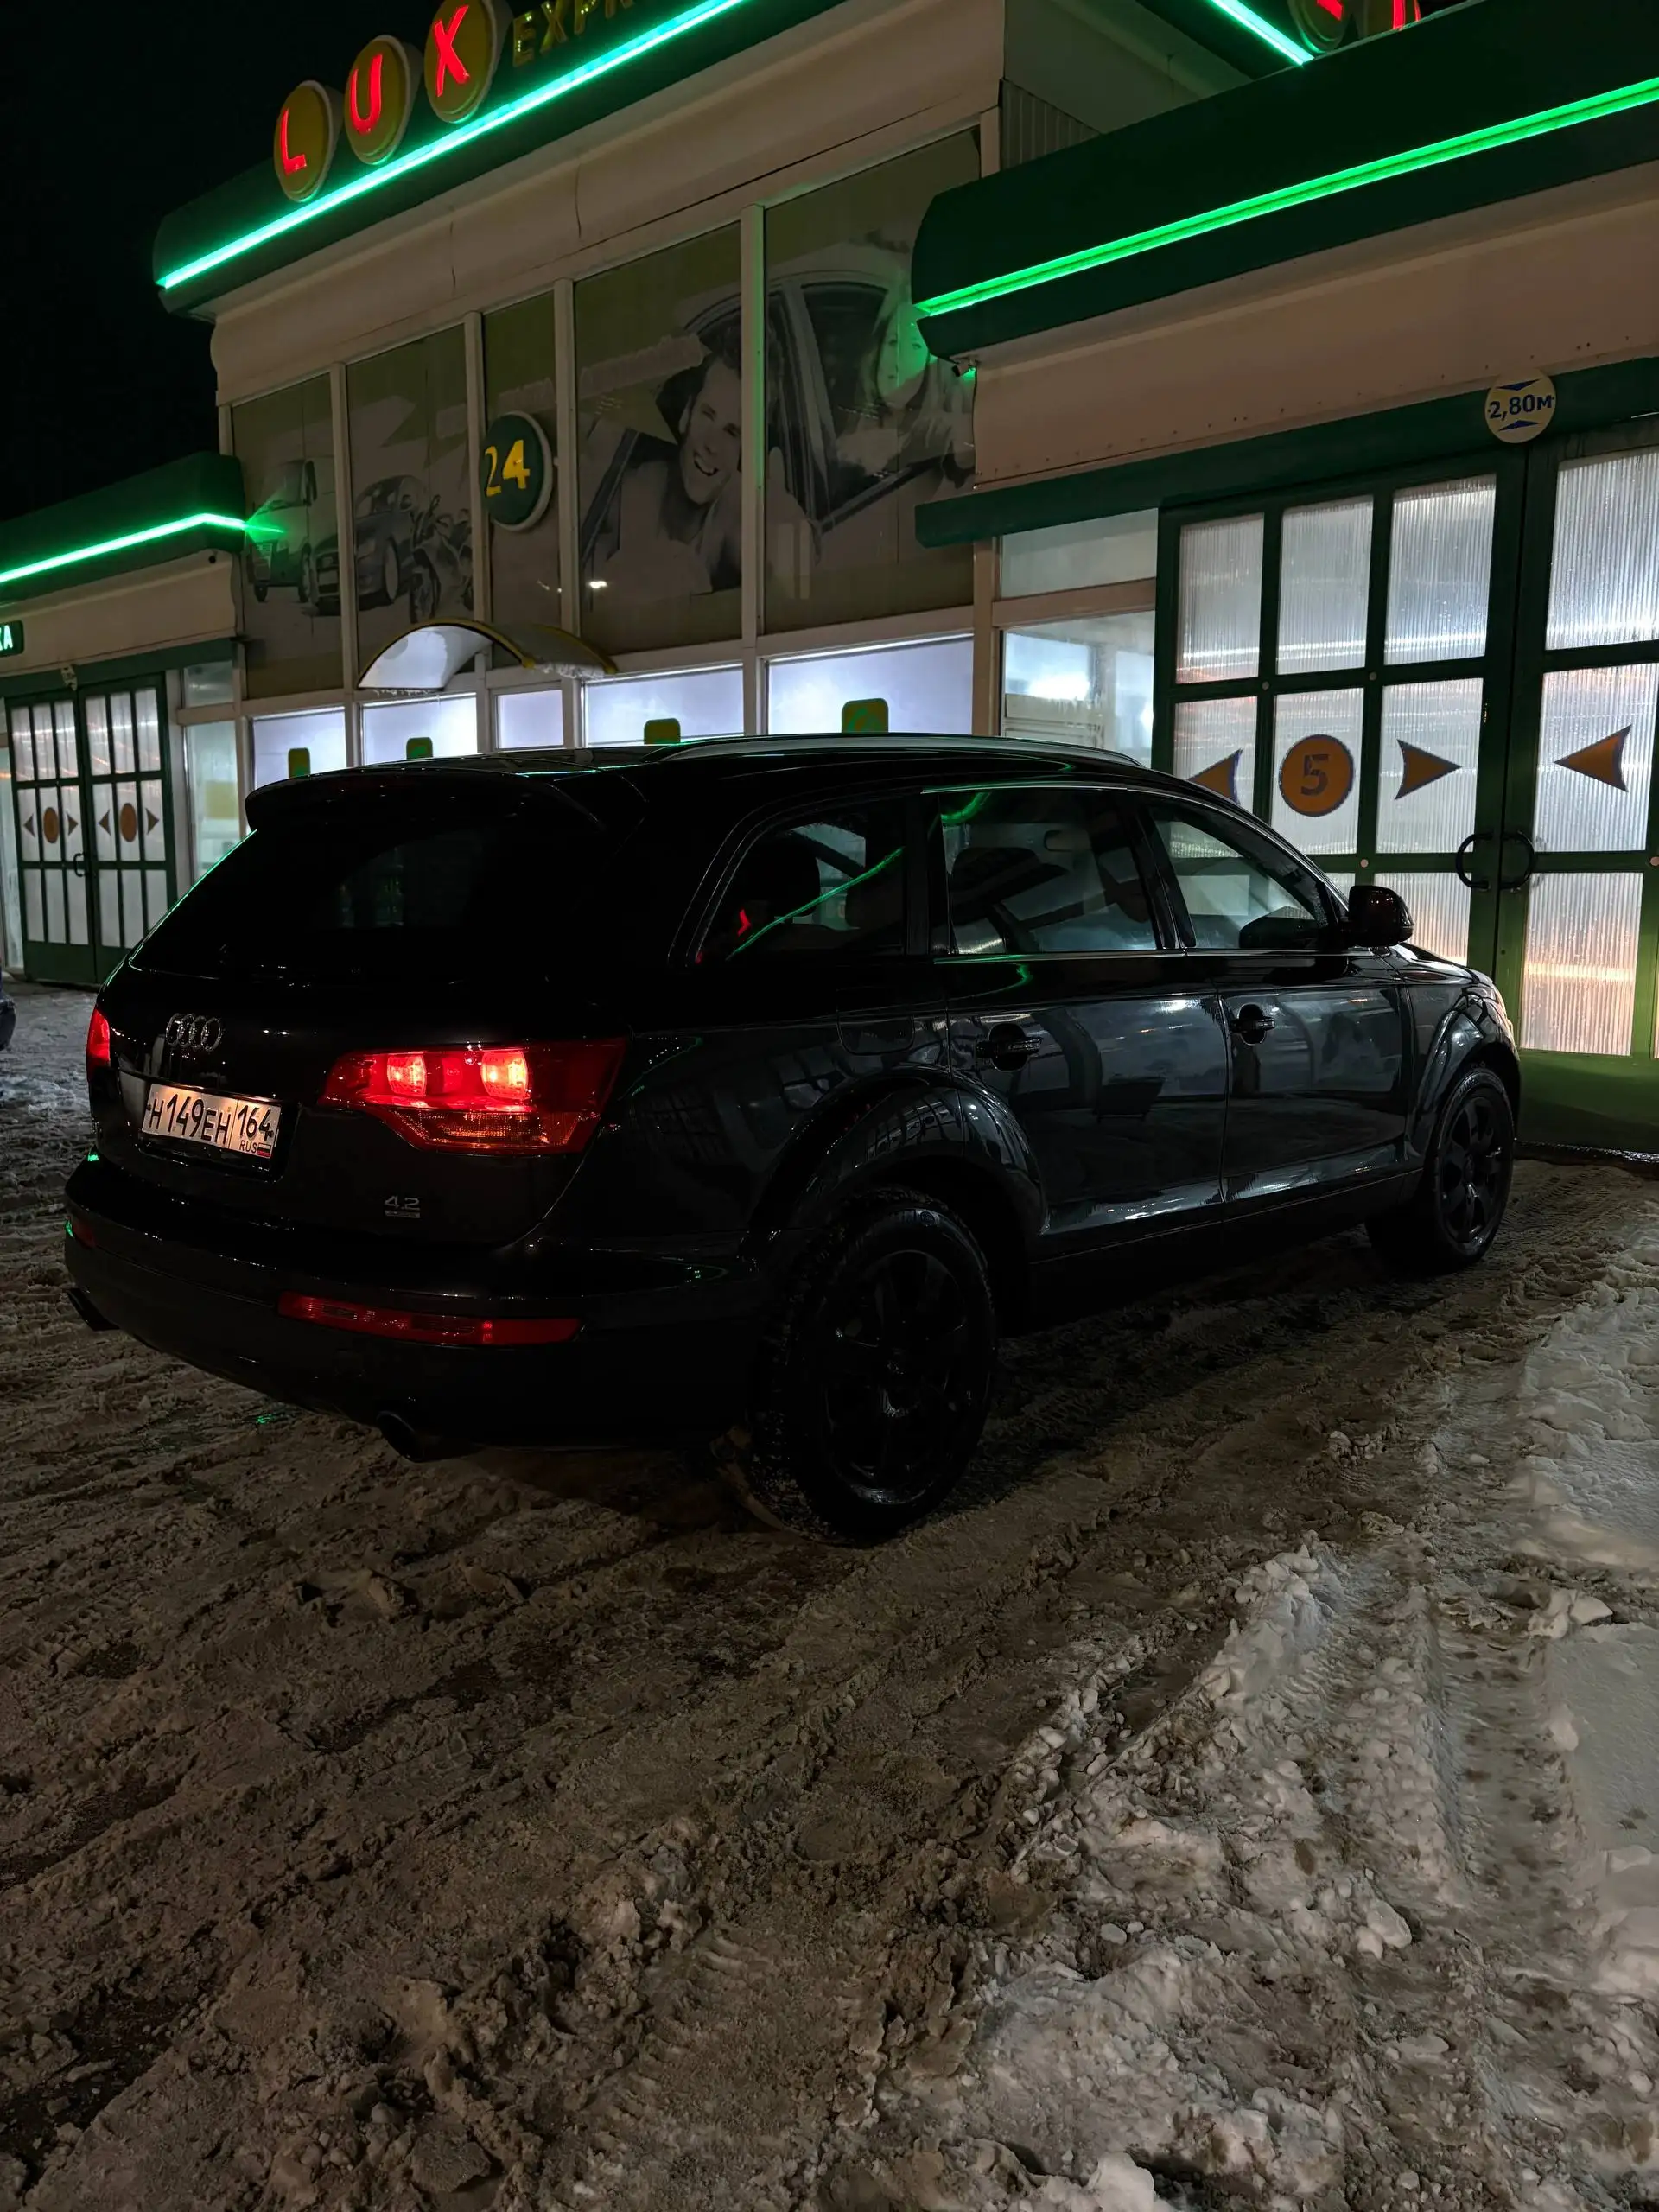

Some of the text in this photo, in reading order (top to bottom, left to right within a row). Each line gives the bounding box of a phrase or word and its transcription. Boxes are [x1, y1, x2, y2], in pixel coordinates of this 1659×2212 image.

[280, 4, 470, 175] LUX
[485, 439, 530, 497] 24
[1300, 753, 1331, 796] 5
[238, 1105, 271, 1141] 164
[239, 1140, 257, 1154] RUS
[384, 1194, 421, 1211] 4.2
